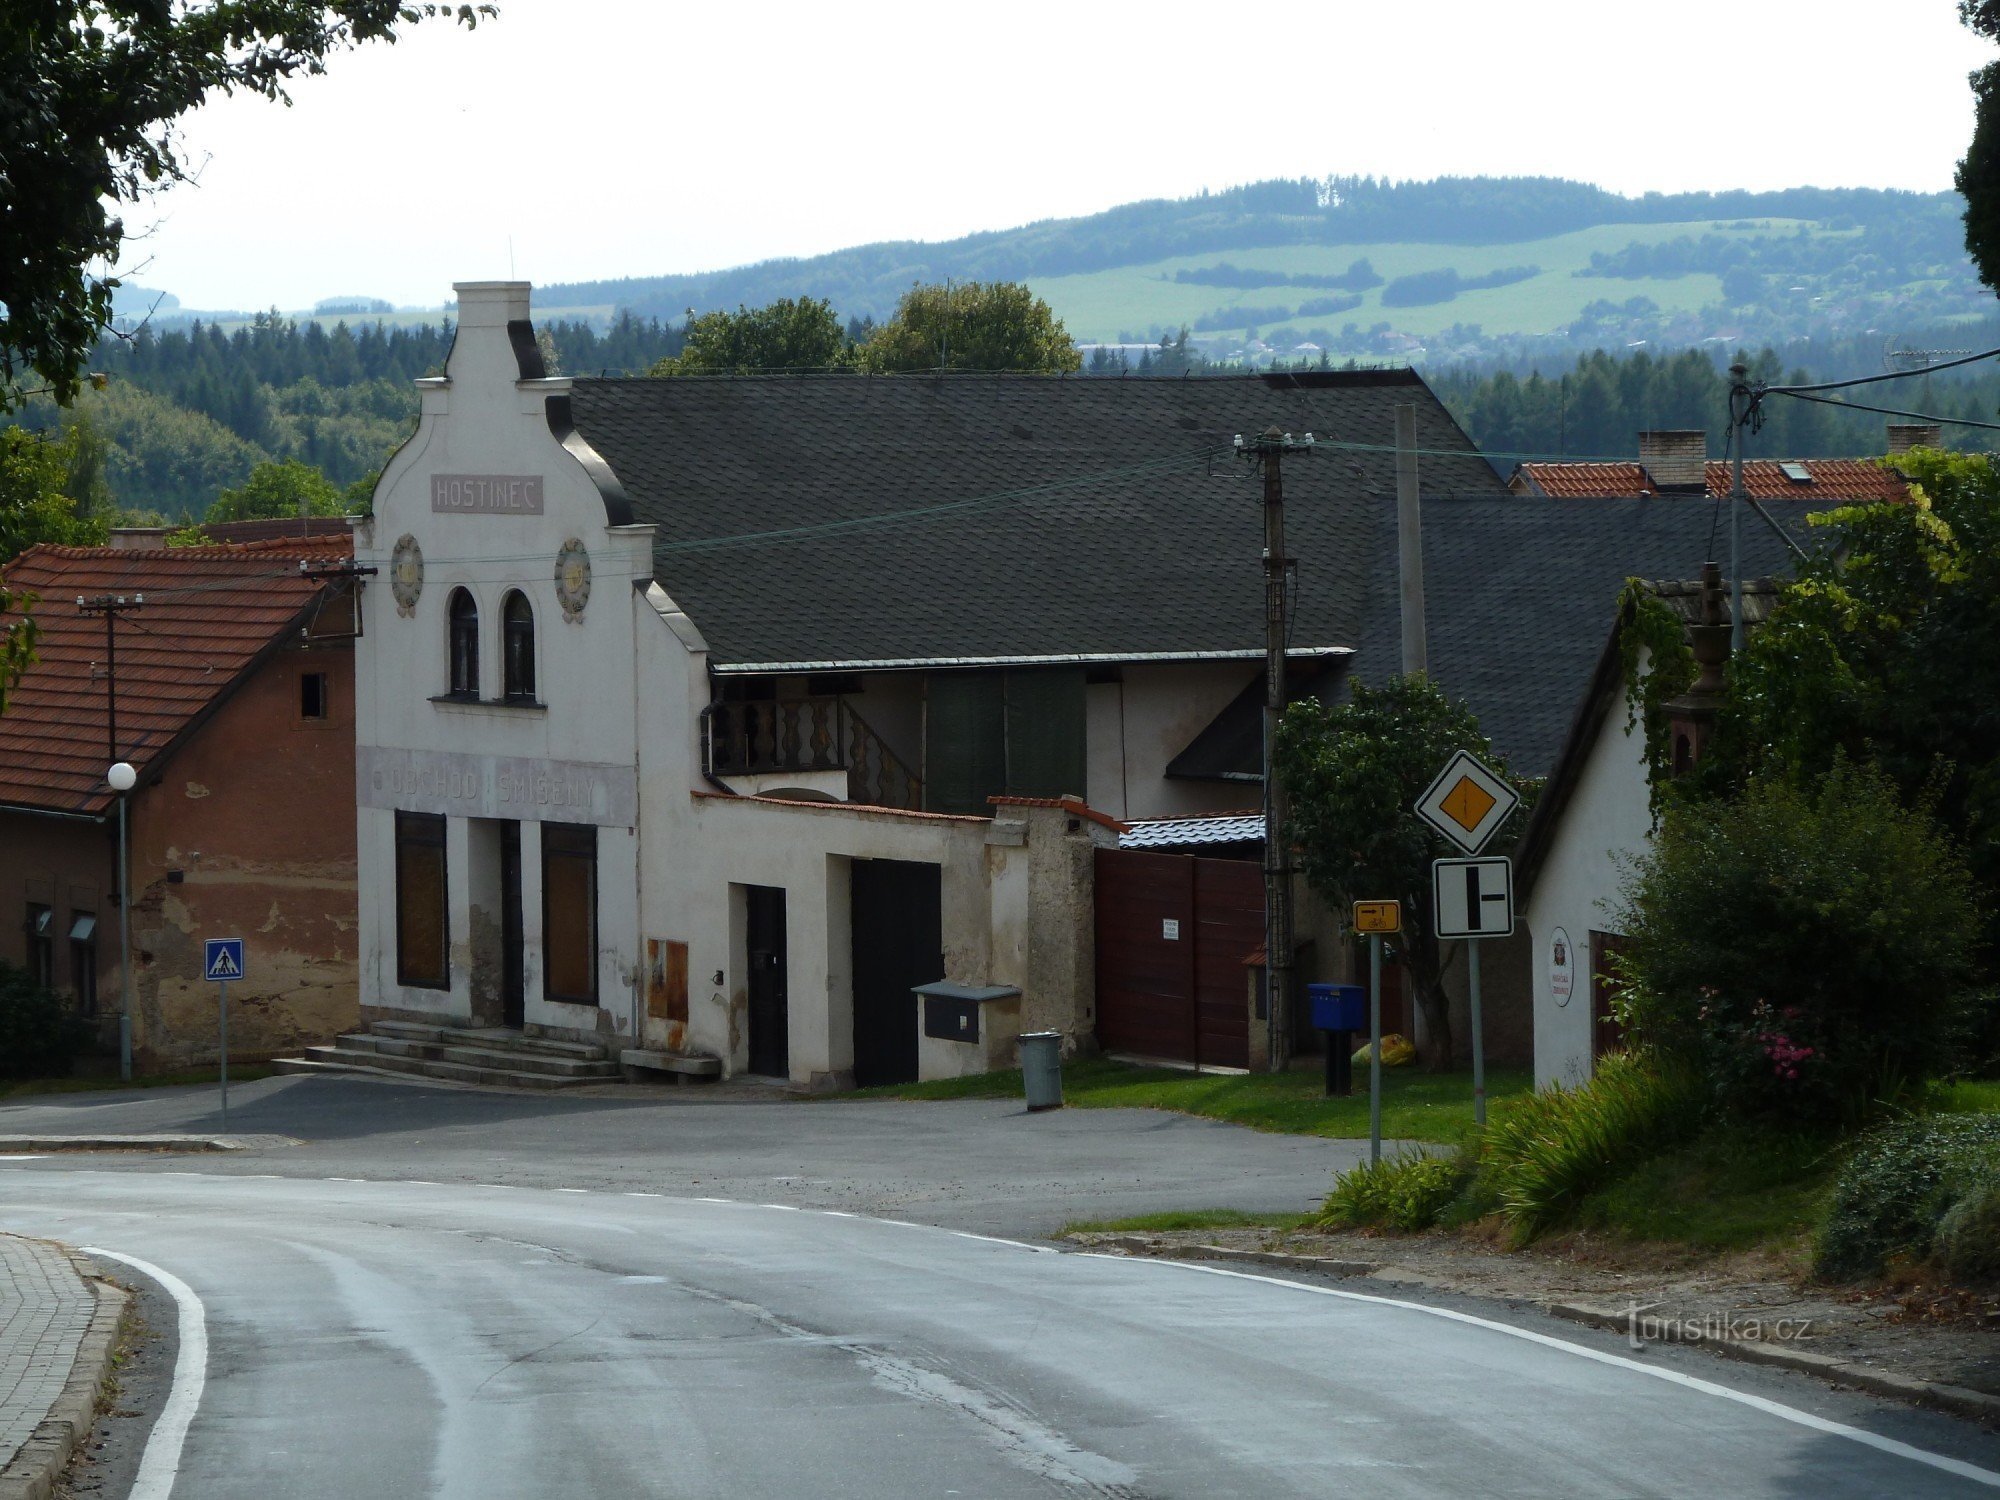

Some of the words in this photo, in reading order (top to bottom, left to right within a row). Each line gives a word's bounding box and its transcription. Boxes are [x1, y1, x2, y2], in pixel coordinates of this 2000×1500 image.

[437, 480, 536, 509] HOSTINEC
[391, 767, 478, 800] OBCHOD
[1379, 905, 1385, 917] 1
